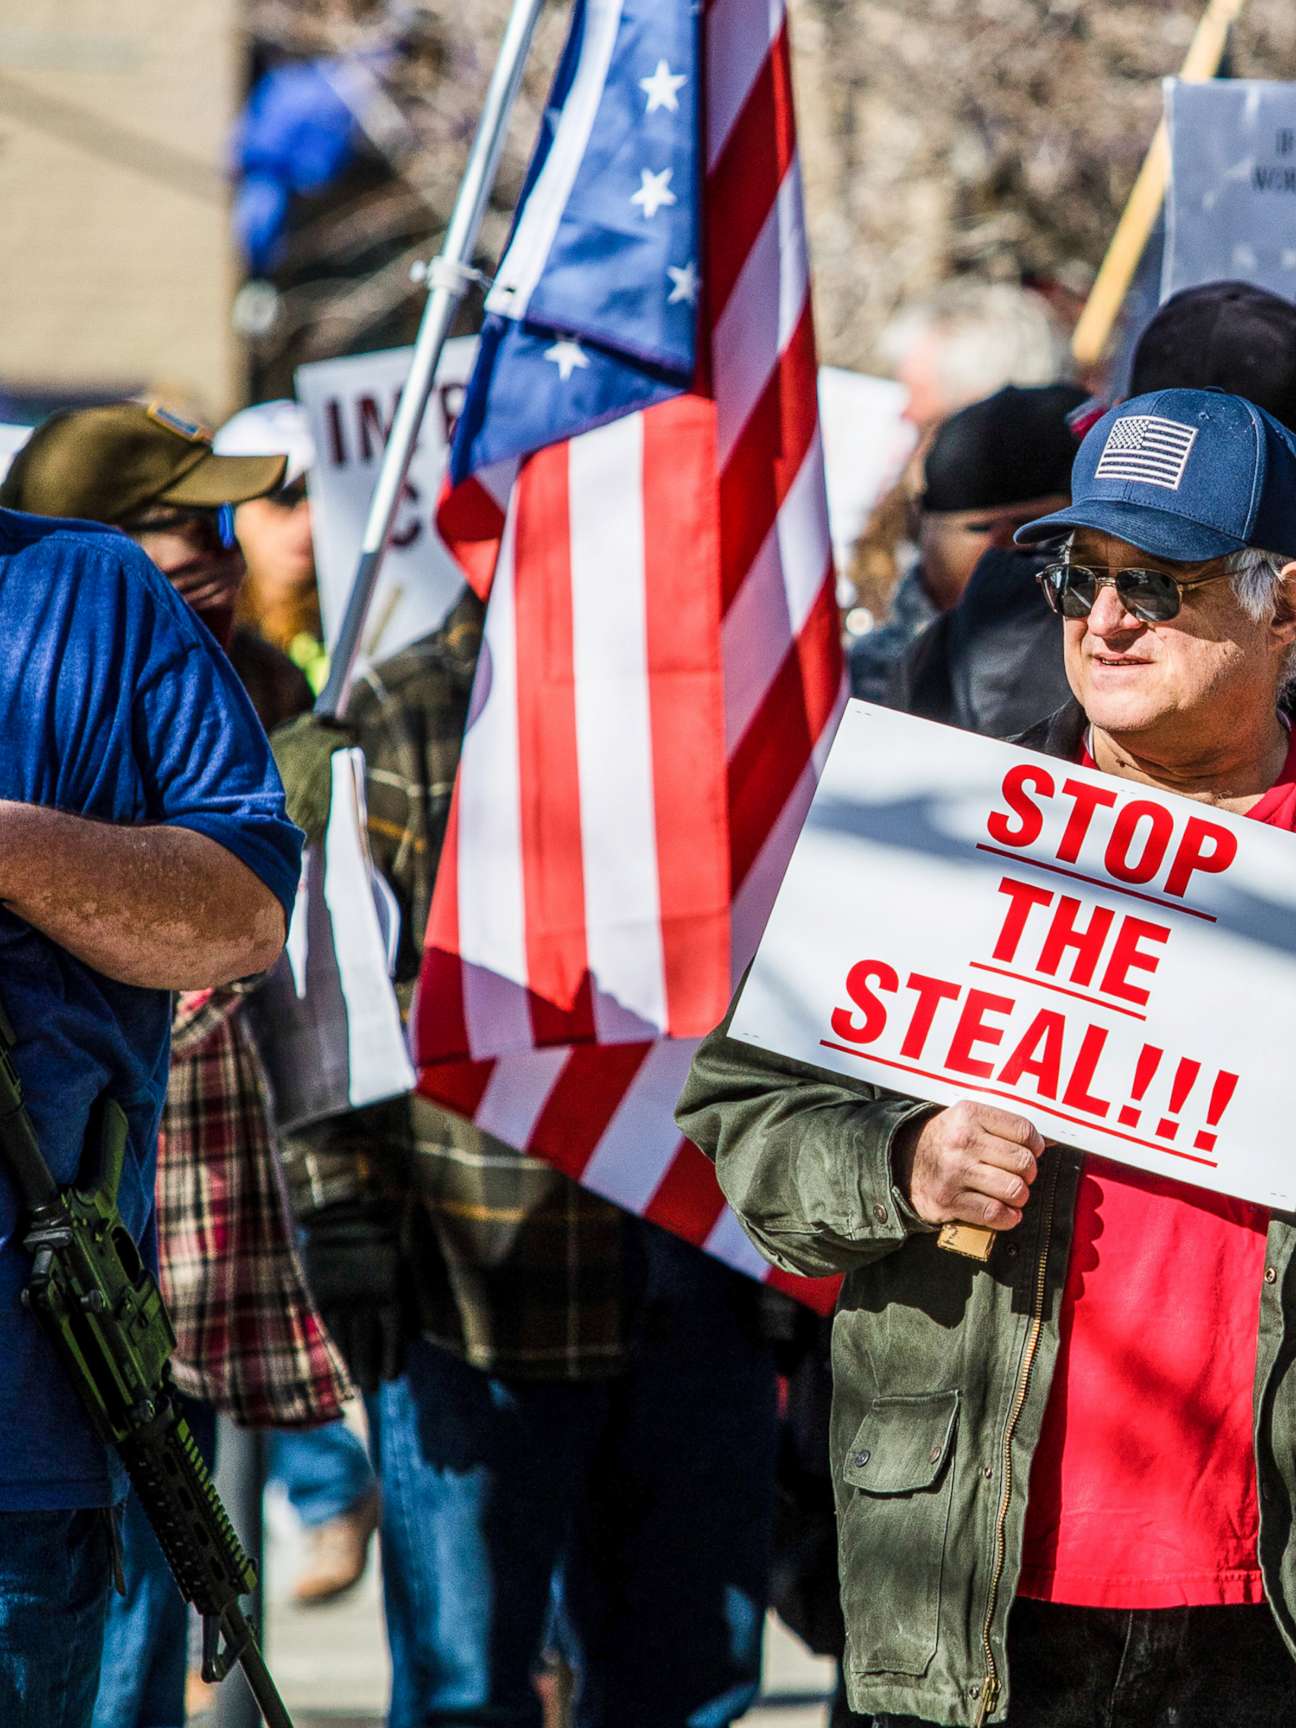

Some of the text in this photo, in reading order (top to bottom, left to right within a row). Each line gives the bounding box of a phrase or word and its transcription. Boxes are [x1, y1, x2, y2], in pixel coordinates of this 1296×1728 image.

[987, 764, 1238, 898] STOP
[992, 877, 1171, 1007] THE
[830, 959, 1240, 1153] STEAL!!!
